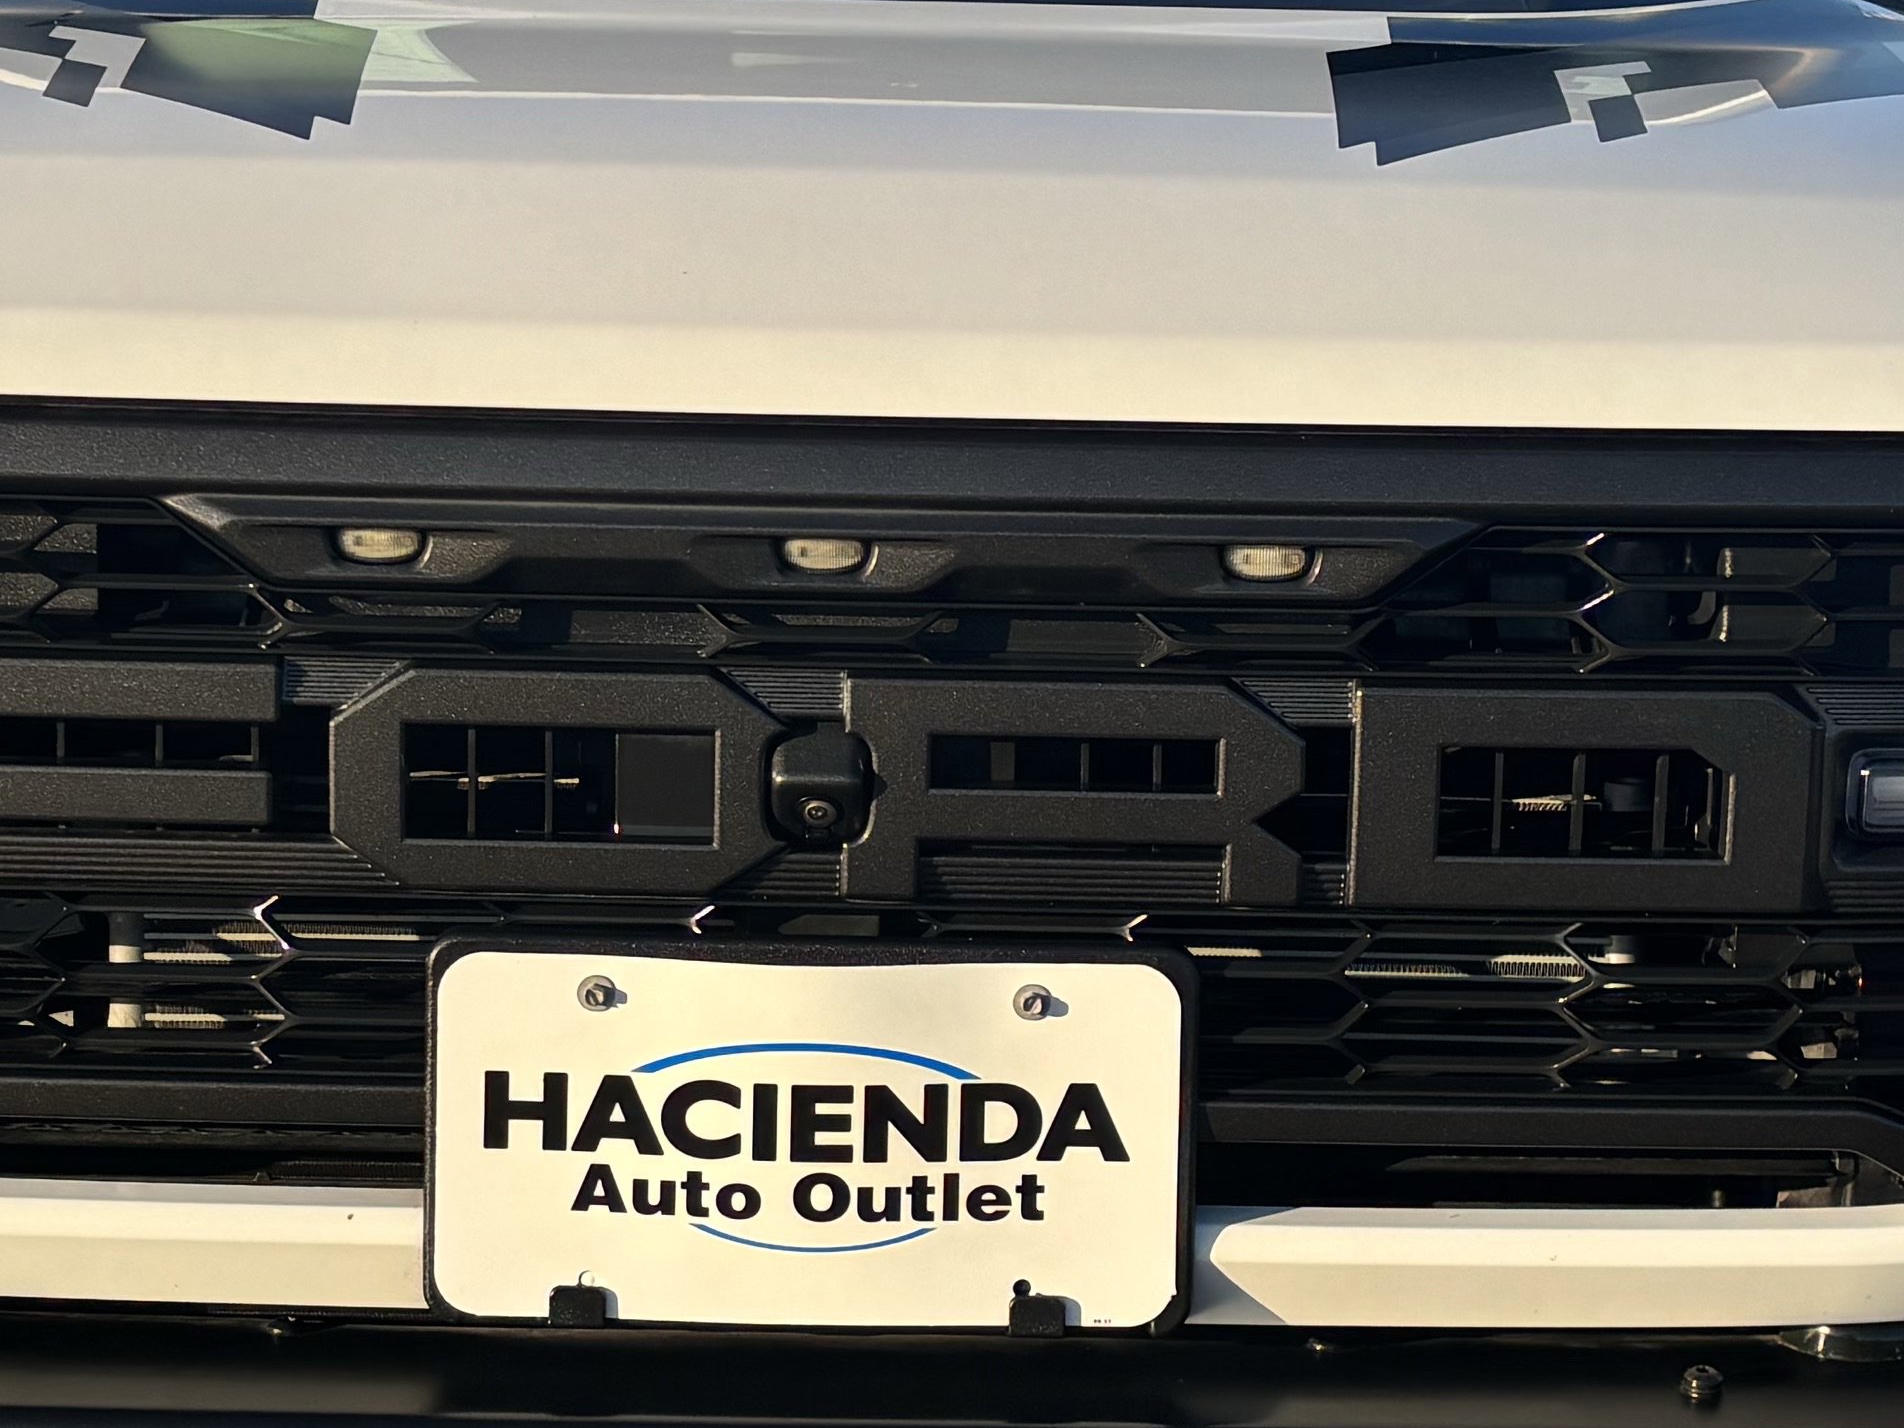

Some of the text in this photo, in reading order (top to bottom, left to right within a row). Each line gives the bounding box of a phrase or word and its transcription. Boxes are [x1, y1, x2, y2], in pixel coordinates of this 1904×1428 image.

[482, 1069, 1130, 1163] HACIENDA
[570, 1163, 1047, 1223] Auto Outlet
